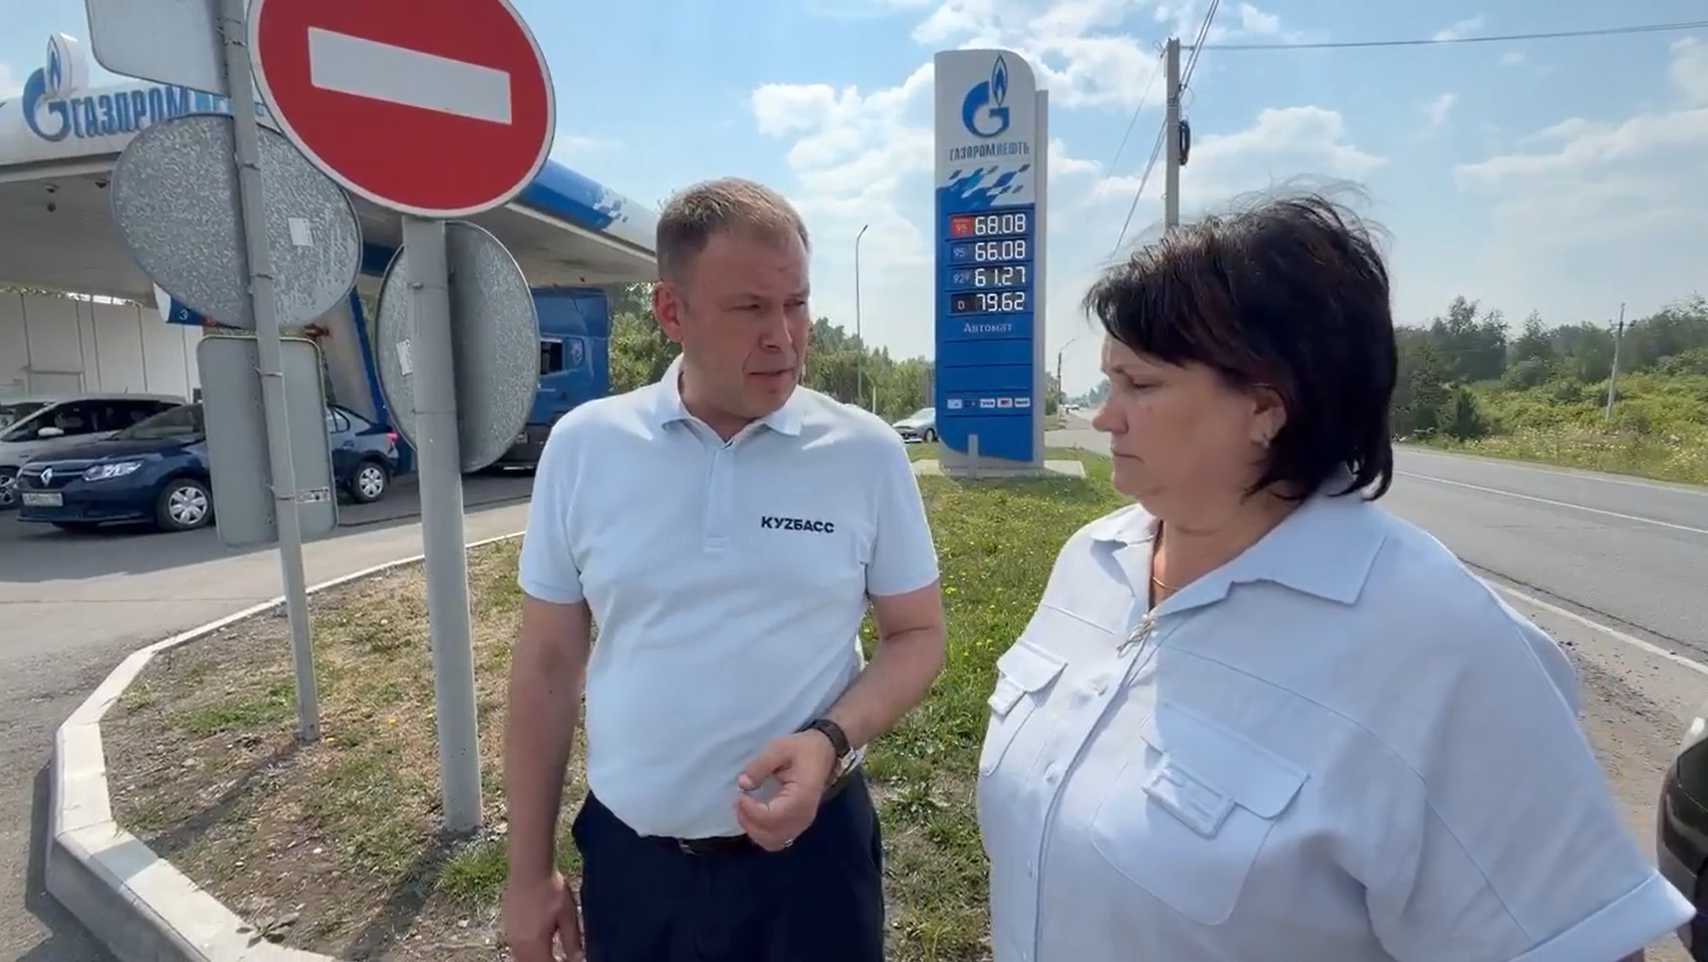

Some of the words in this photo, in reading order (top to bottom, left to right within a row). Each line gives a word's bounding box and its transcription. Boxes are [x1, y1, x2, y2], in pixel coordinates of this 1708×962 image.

[949, 142, 1030, 161] ГАЗПРОМНЕФТЬ
[975, 213, 1026, 235] 68.08
[975, 240, 1026, 261] 66.08
[975, 265, 1026, 287] 61.27
[976, 291, 1025, 312] 79.62
[963, 322, 1012, 333] Автомат
[761, 516, 835, 533] КУZБАСС
